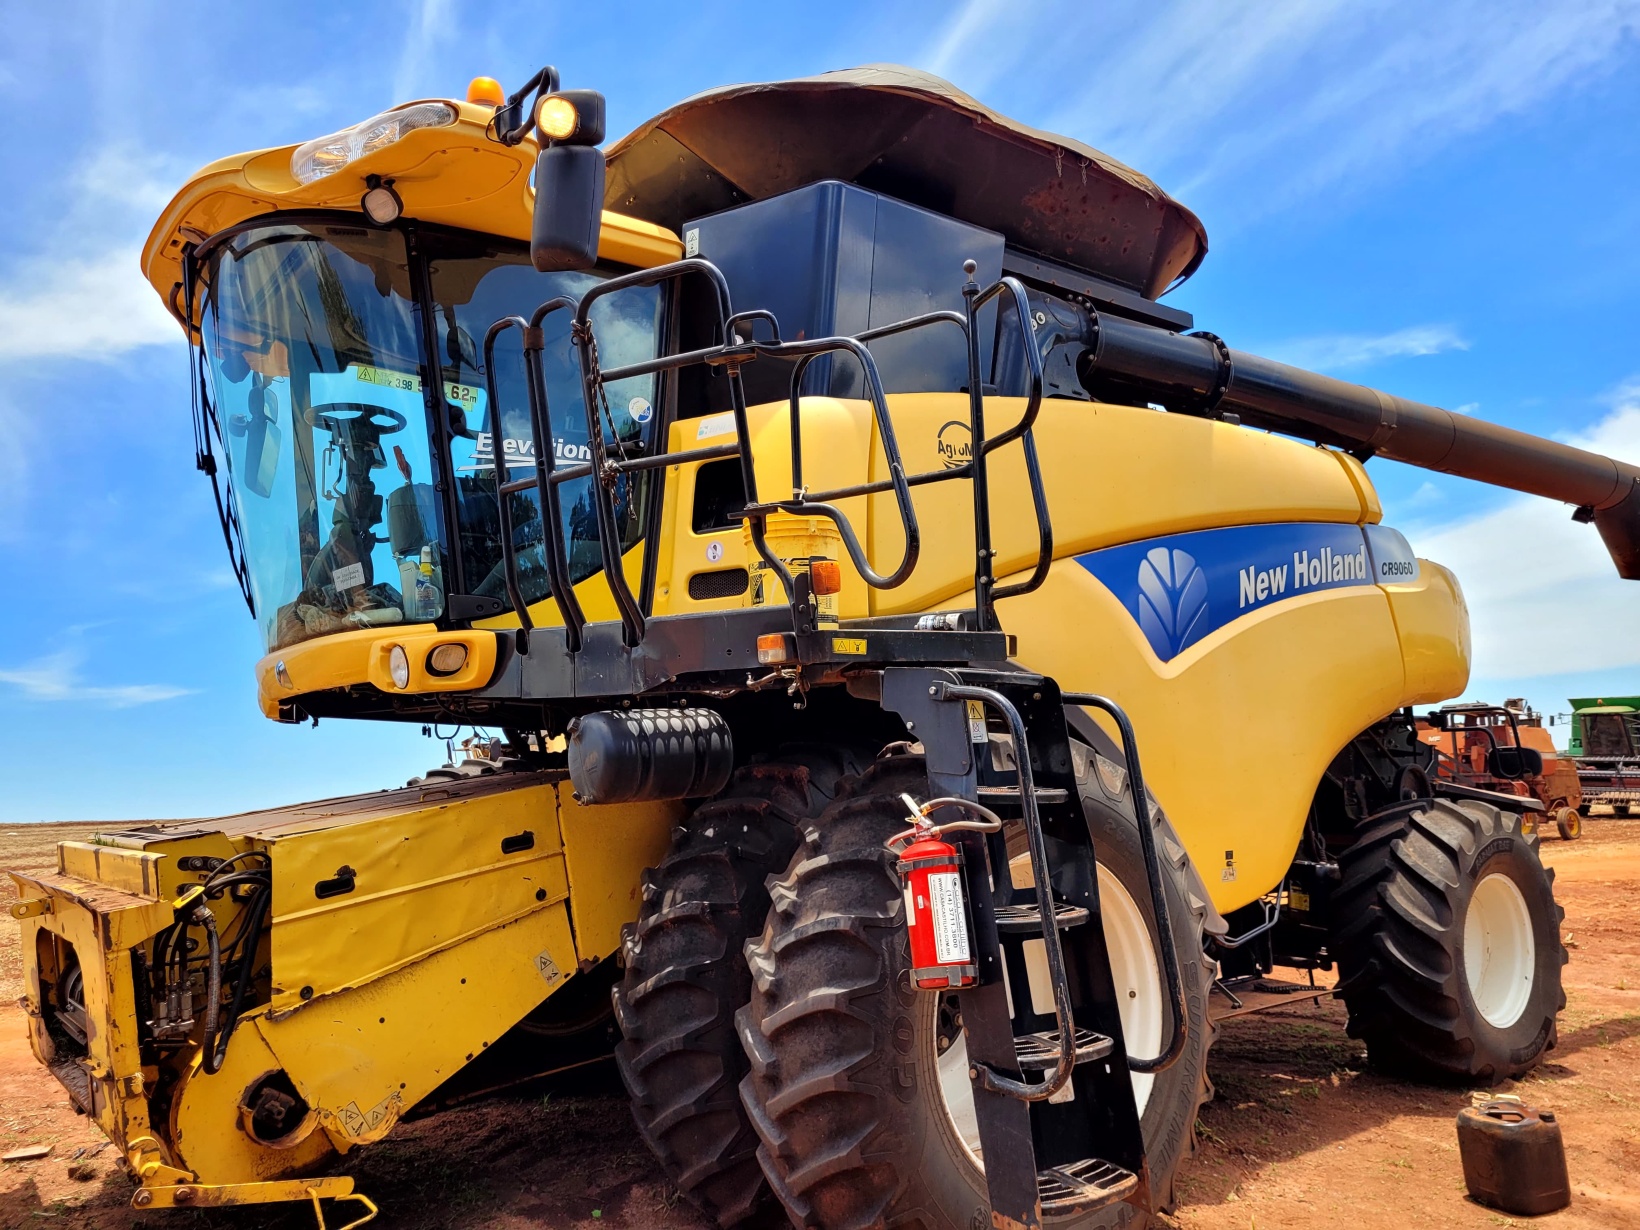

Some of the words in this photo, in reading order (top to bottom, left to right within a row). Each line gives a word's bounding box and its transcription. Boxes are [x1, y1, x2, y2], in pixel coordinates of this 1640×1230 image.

[395, 379, 413, 391] 3.98
[476, 432, 592, 460] Eevion
[1239, 563, 1288, 609] New
[1293, 543, 1367, 589] Holland
[1381, 561, 1414, 576] CR9060
[1428, 735, 1441, 743] MF
